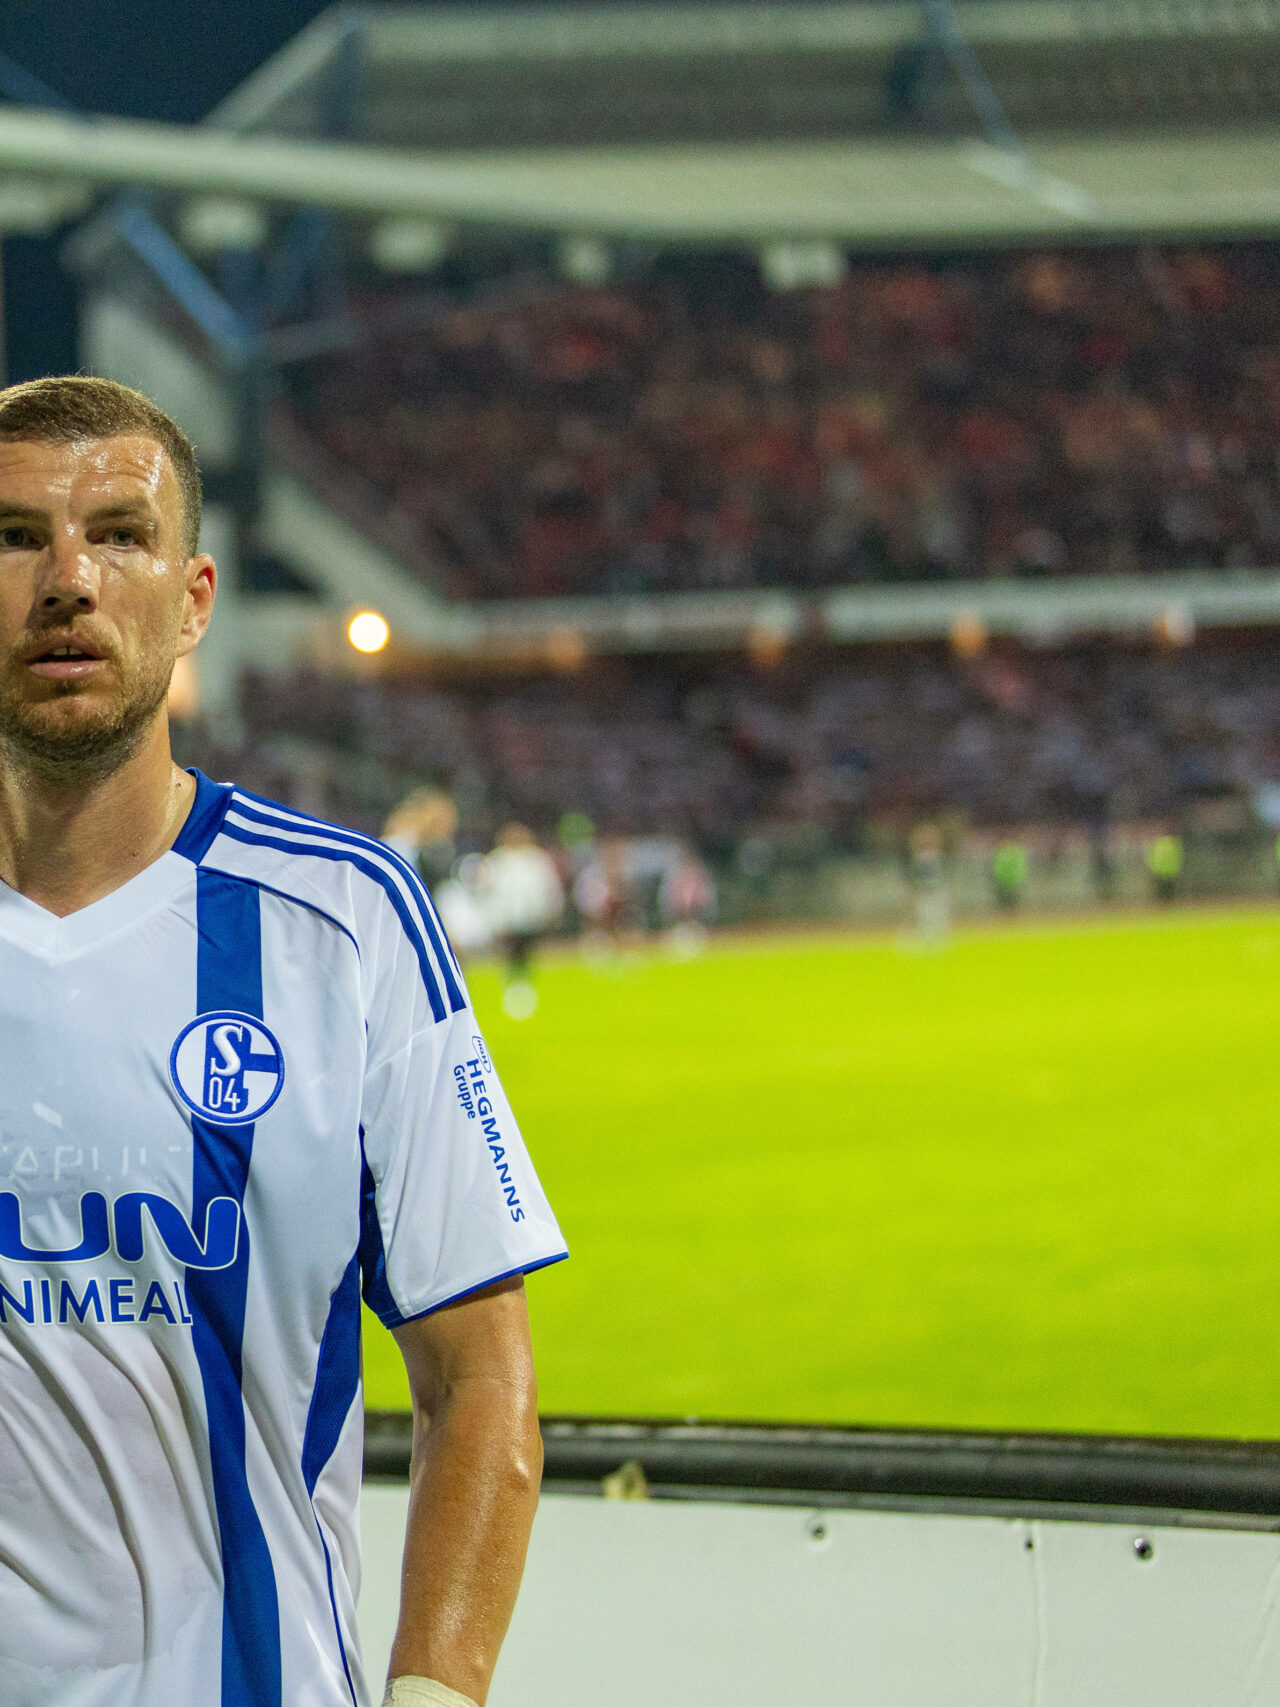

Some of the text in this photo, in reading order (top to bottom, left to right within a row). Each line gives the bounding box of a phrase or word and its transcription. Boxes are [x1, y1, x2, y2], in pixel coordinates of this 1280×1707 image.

[210, 1025, 244, 1077] S
[208, 1076, 241, 1112] 04
[453, 1064, 476, 1119] Gruppe
[466, 1058, 525, 1222] HEGMANNS
